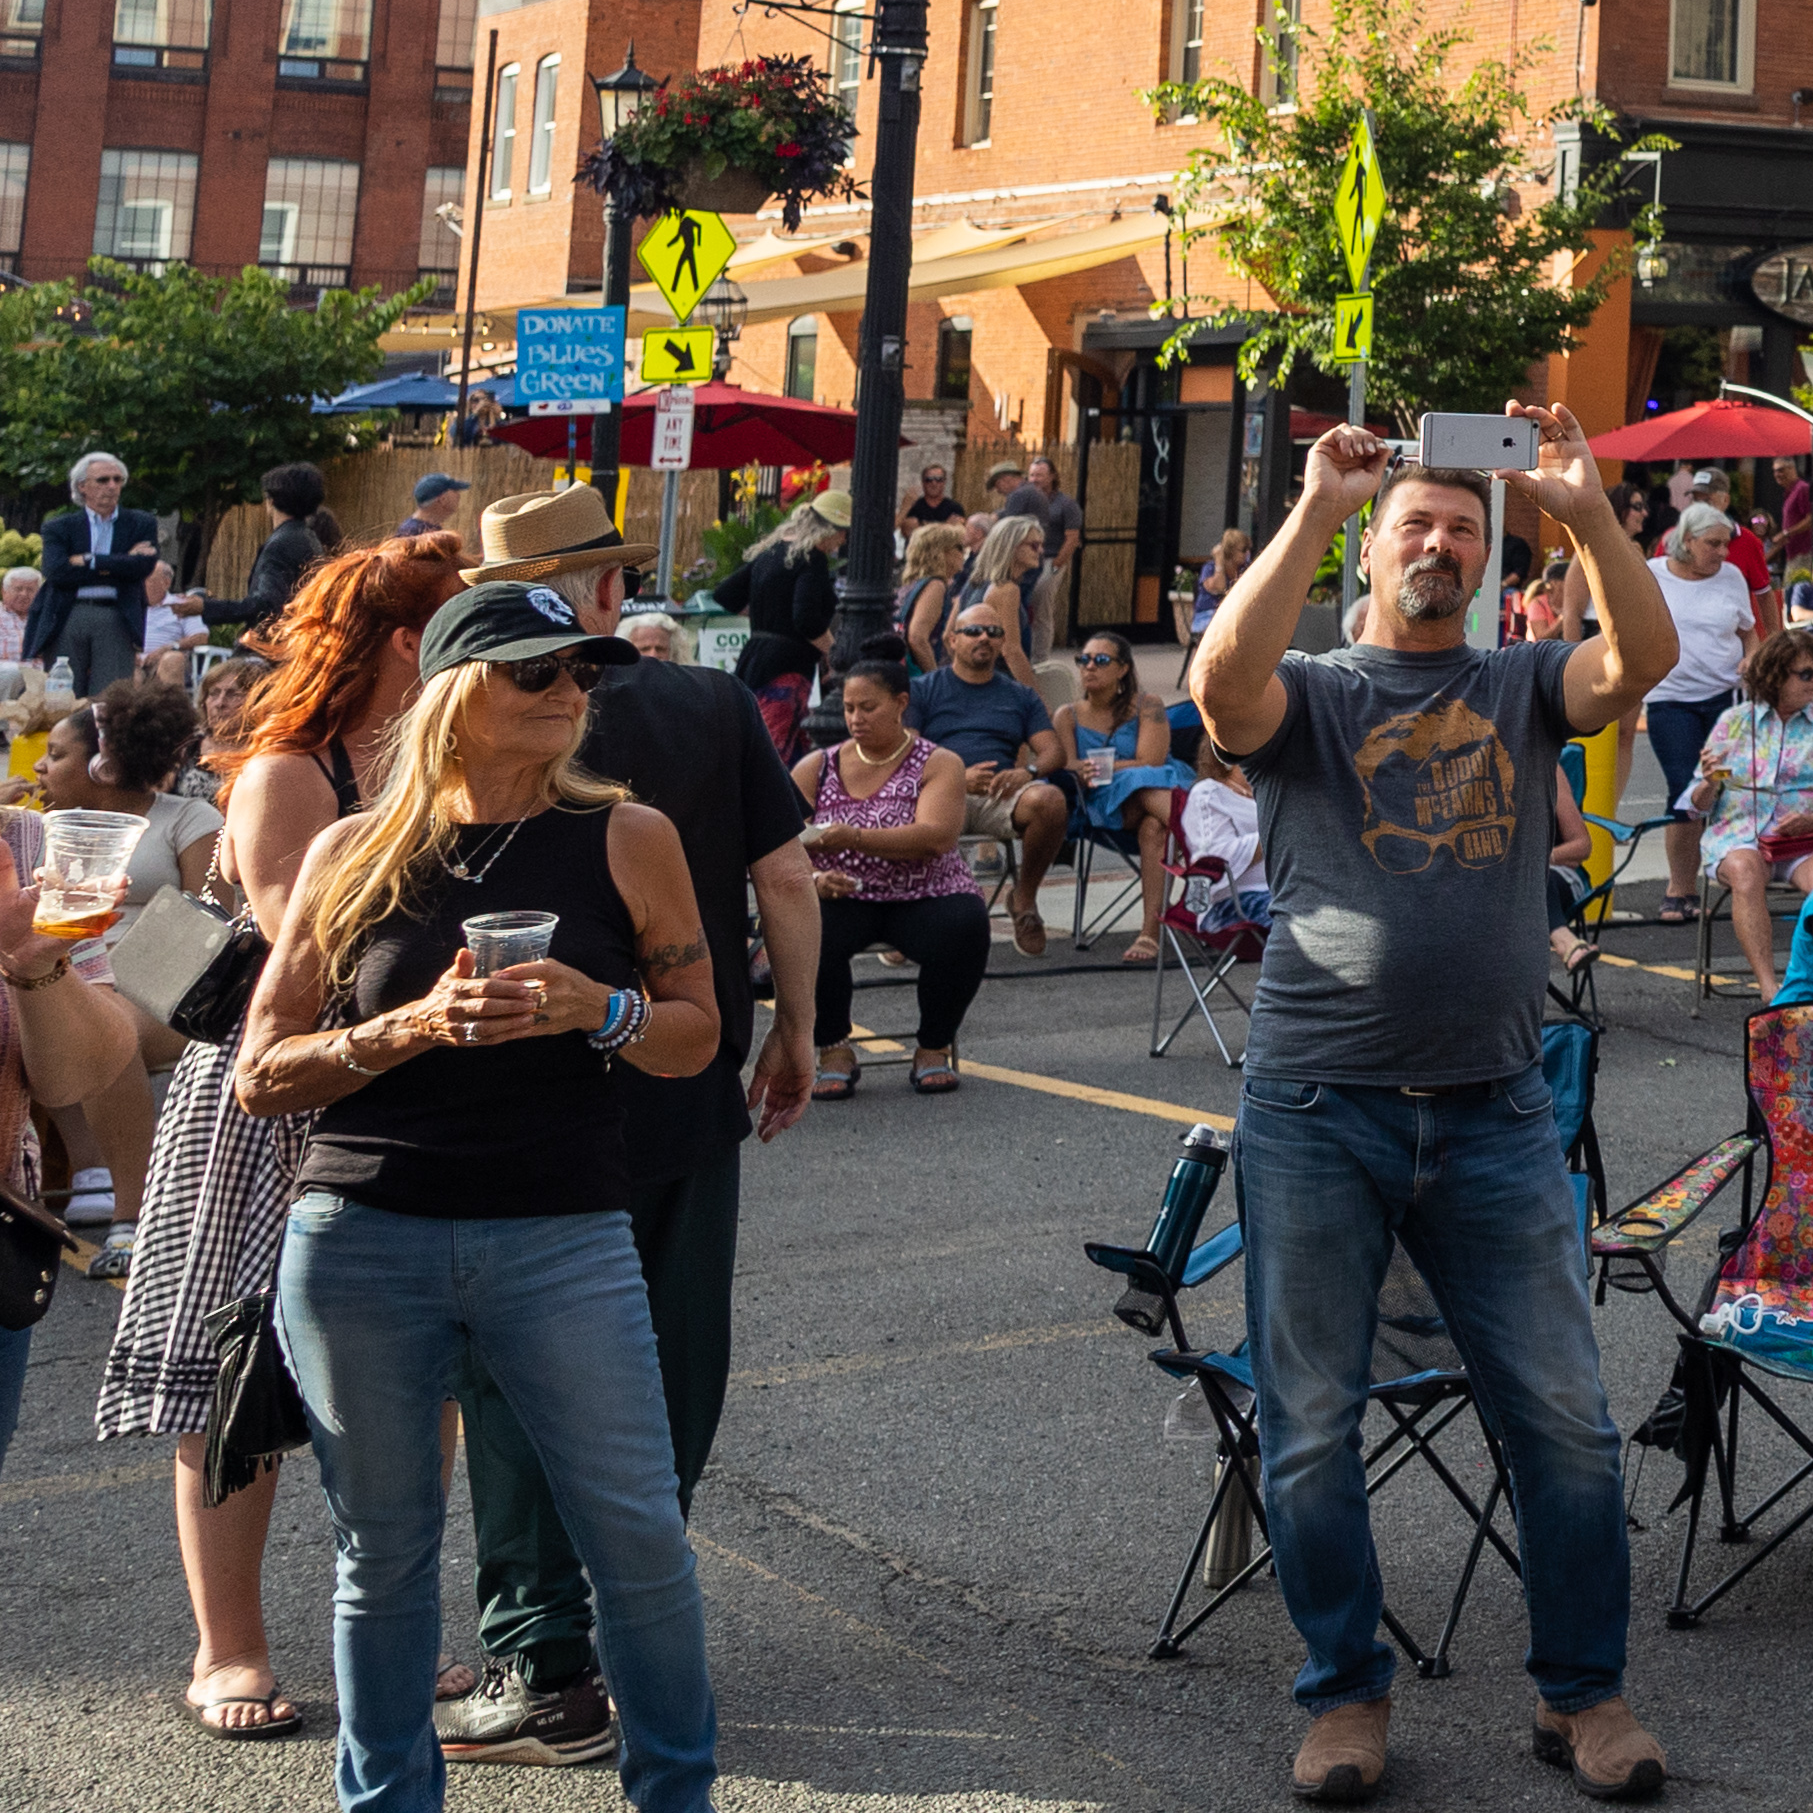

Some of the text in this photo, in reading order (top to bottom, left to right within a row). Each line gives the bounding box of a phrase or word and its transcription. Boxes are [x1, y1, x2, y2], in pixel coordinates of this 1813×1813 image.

[522, 315, 616, 335] DONATE
[665, 418, 684, 433] ANY
[663, 436, 682, 452] TIME
[1430, 743, 1492, 792] BUDDY
[1463, 828, 1503, 860] BAND
